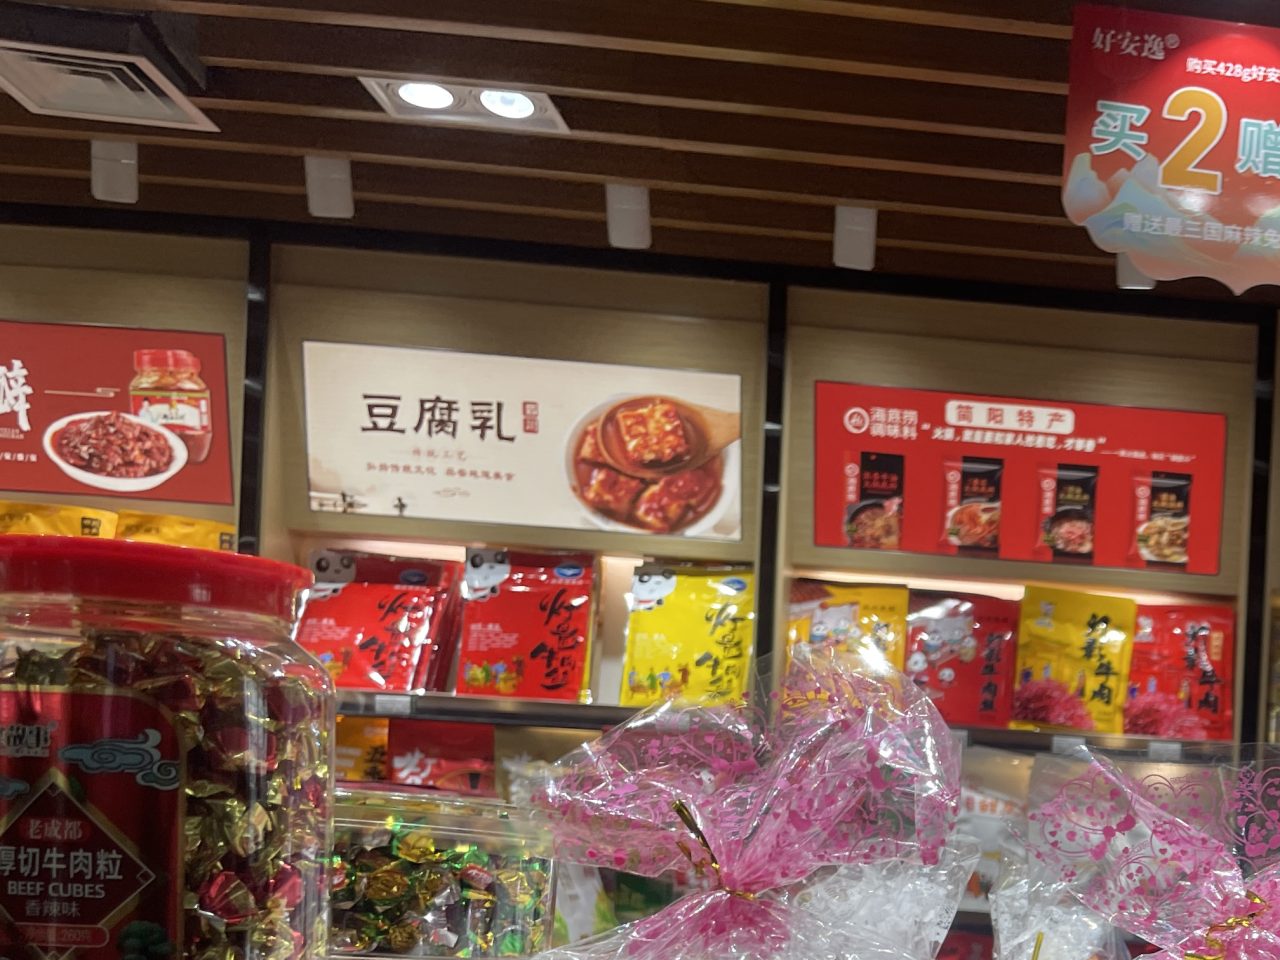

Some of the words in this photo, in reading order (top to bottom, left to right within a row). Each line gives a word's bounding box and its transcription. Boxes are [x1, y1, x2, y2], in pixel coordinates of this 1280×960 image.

[361, 395, 516, 442] 豆腐乳
[26, 818, 83, 841] 老成都
[8, 880, 45, 897] BEEF
[48, 881, 107, 899] CUBES
[25, 900, 81, 919] 香辣味
